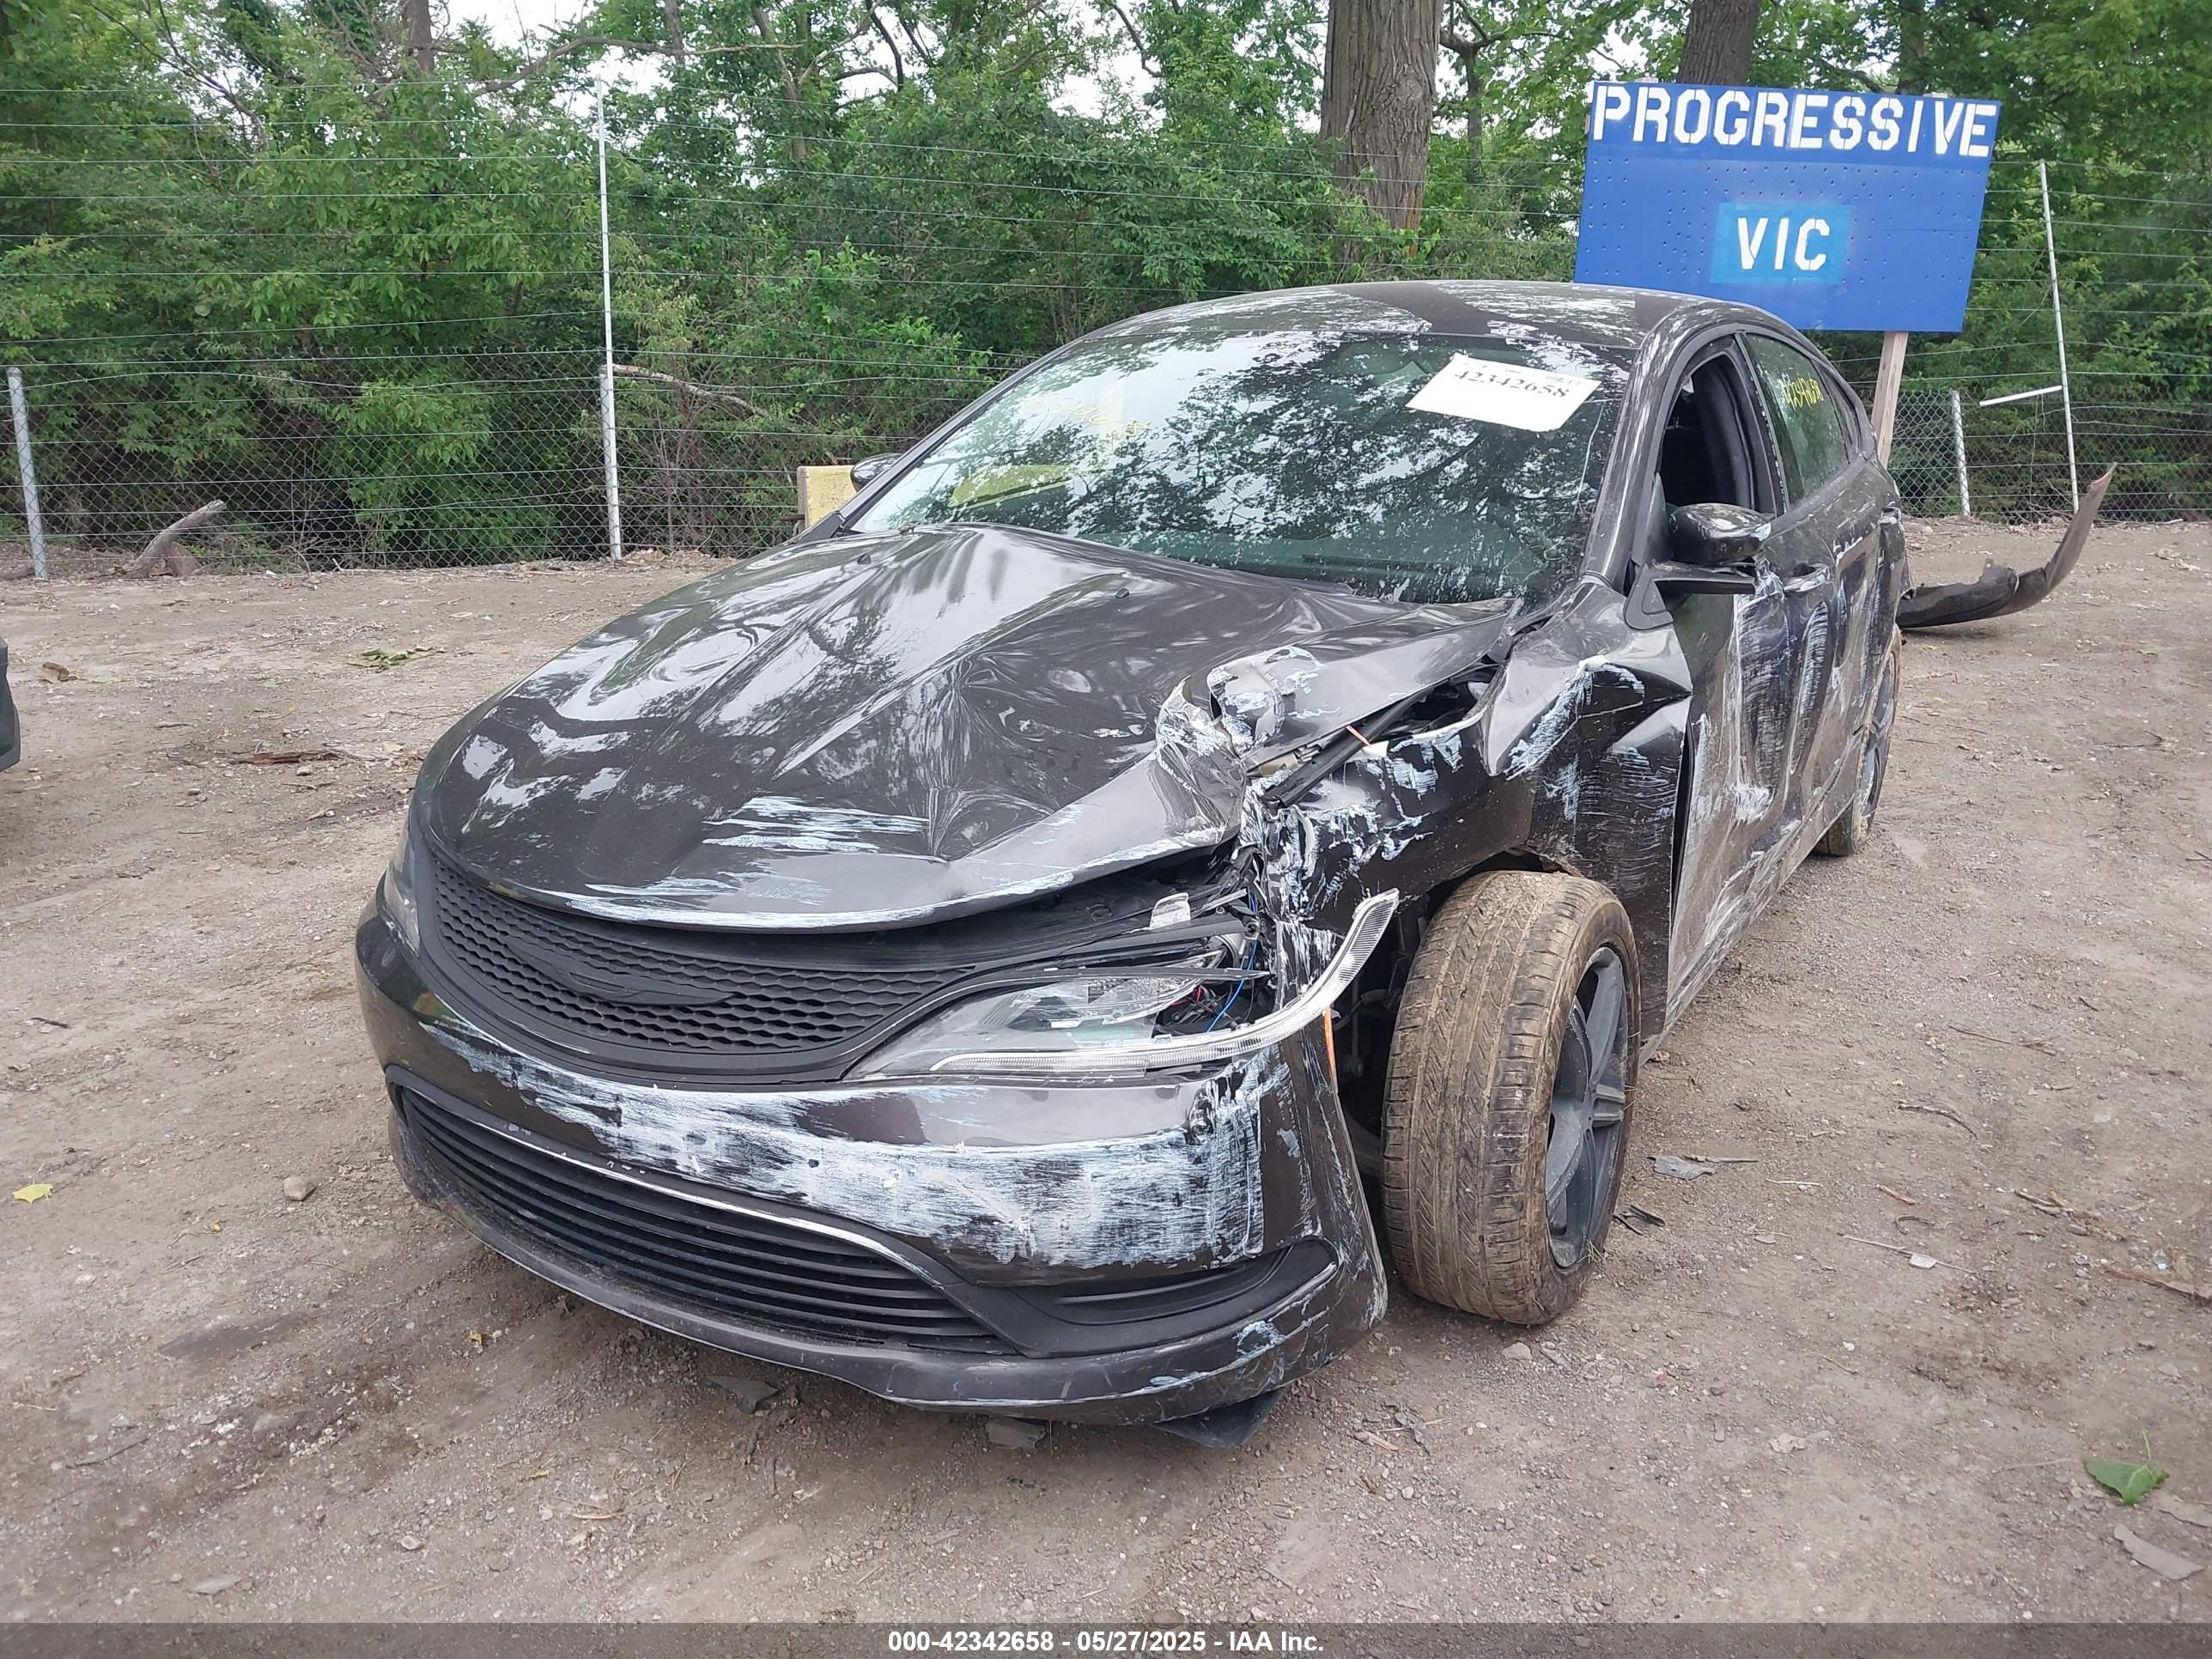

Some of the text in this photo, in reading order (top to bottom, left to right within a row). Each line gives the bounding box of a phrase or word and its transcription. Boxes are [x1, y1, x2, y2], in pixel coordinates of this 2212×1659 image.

[1593, 86, 1997, 157] PROGRESSIVE
[1737, 217, 1831, 271] VIC
[1453, 370, 1571, 398] 42342658
